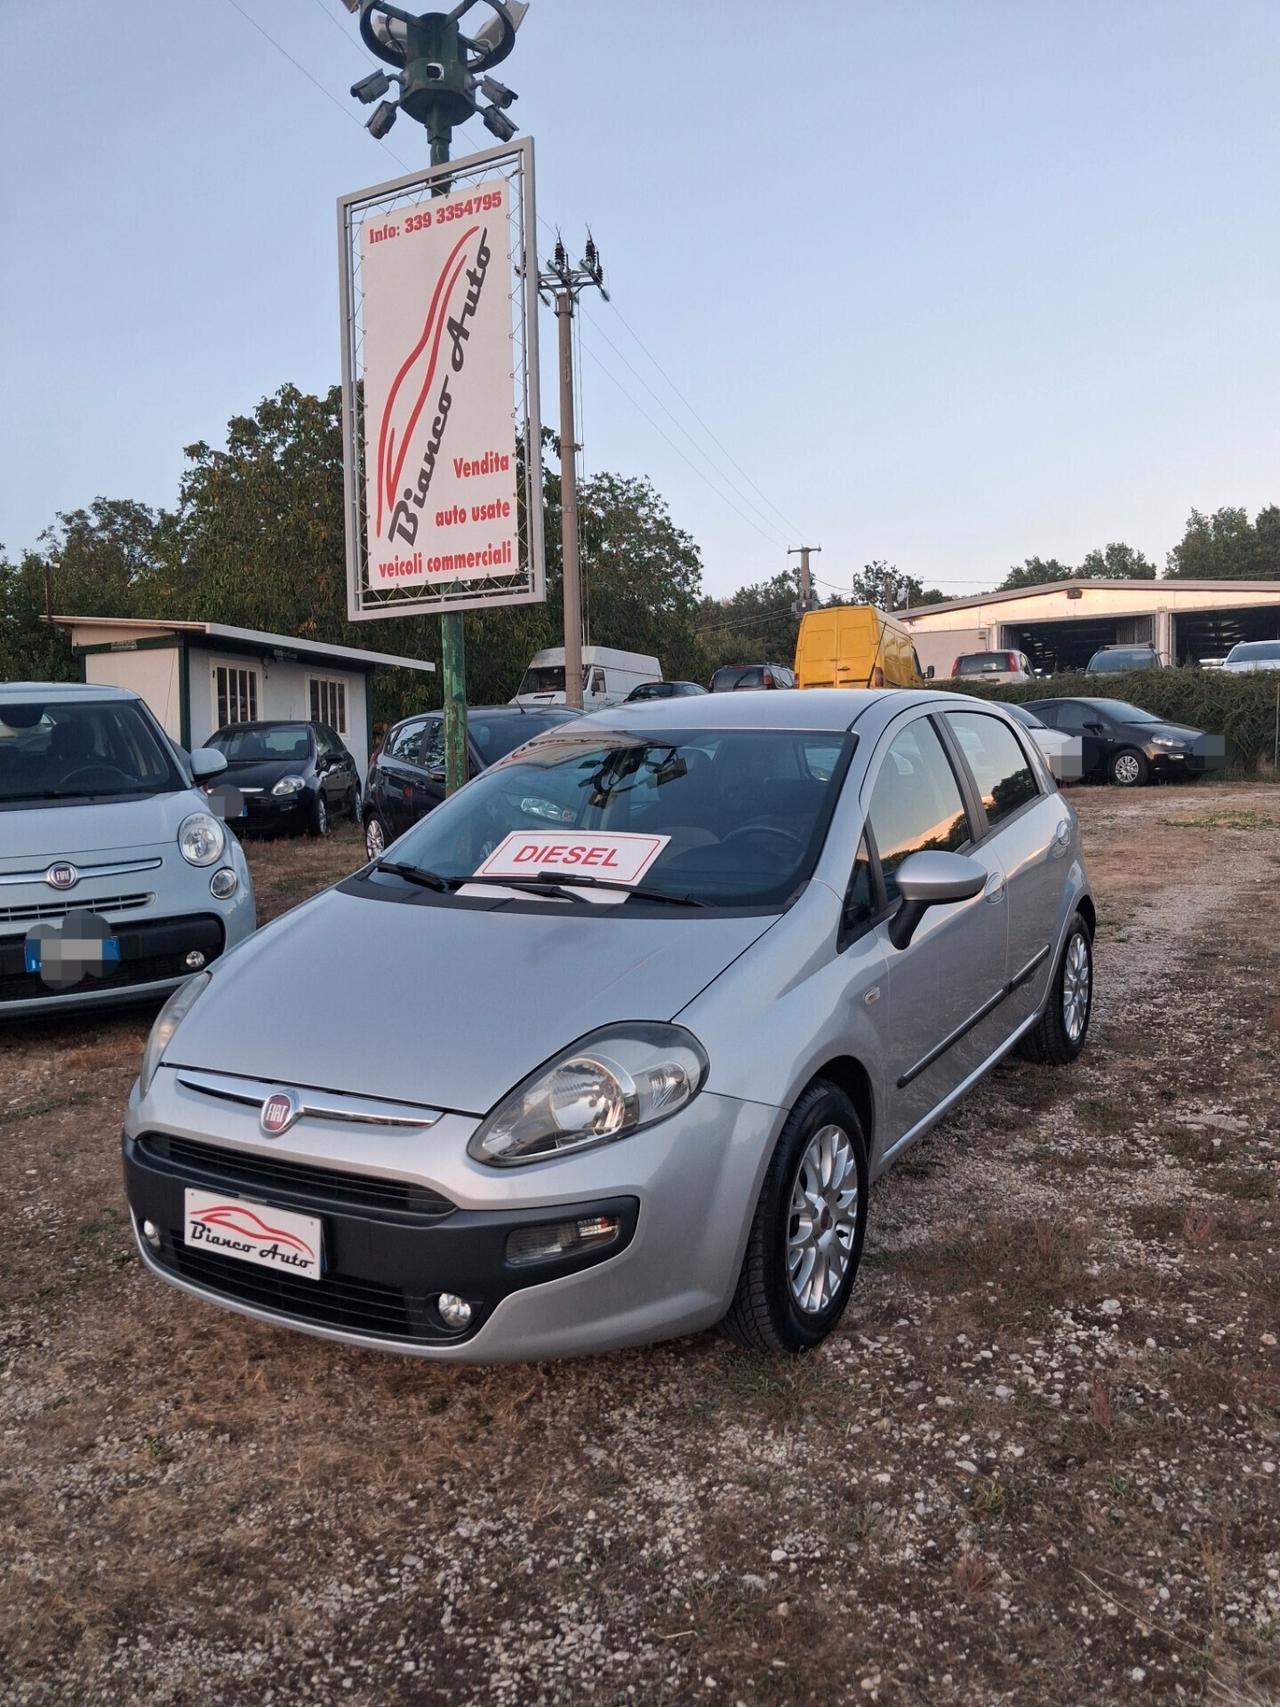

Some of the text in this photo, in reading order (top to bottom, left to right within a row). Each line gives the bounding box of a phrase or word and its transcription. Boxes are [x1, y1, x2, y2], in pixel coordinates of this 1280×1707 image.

[369, 191, 502, 244] Info: 339 3354795
[387, 227, 491, 547] Bianco Auto
[453, 451, 509, 479] Vendita
[435, 498, 510, 527] auto usate
[379, 540, 512, 578] veicoli commerciali
[512, 845, 619, 867] DIESEL
[56, 870, 70, 881] FIAT
[266, 1103, 288, 1122] FIAT
[190, 1220, 314, 1269] Bianco Auto
